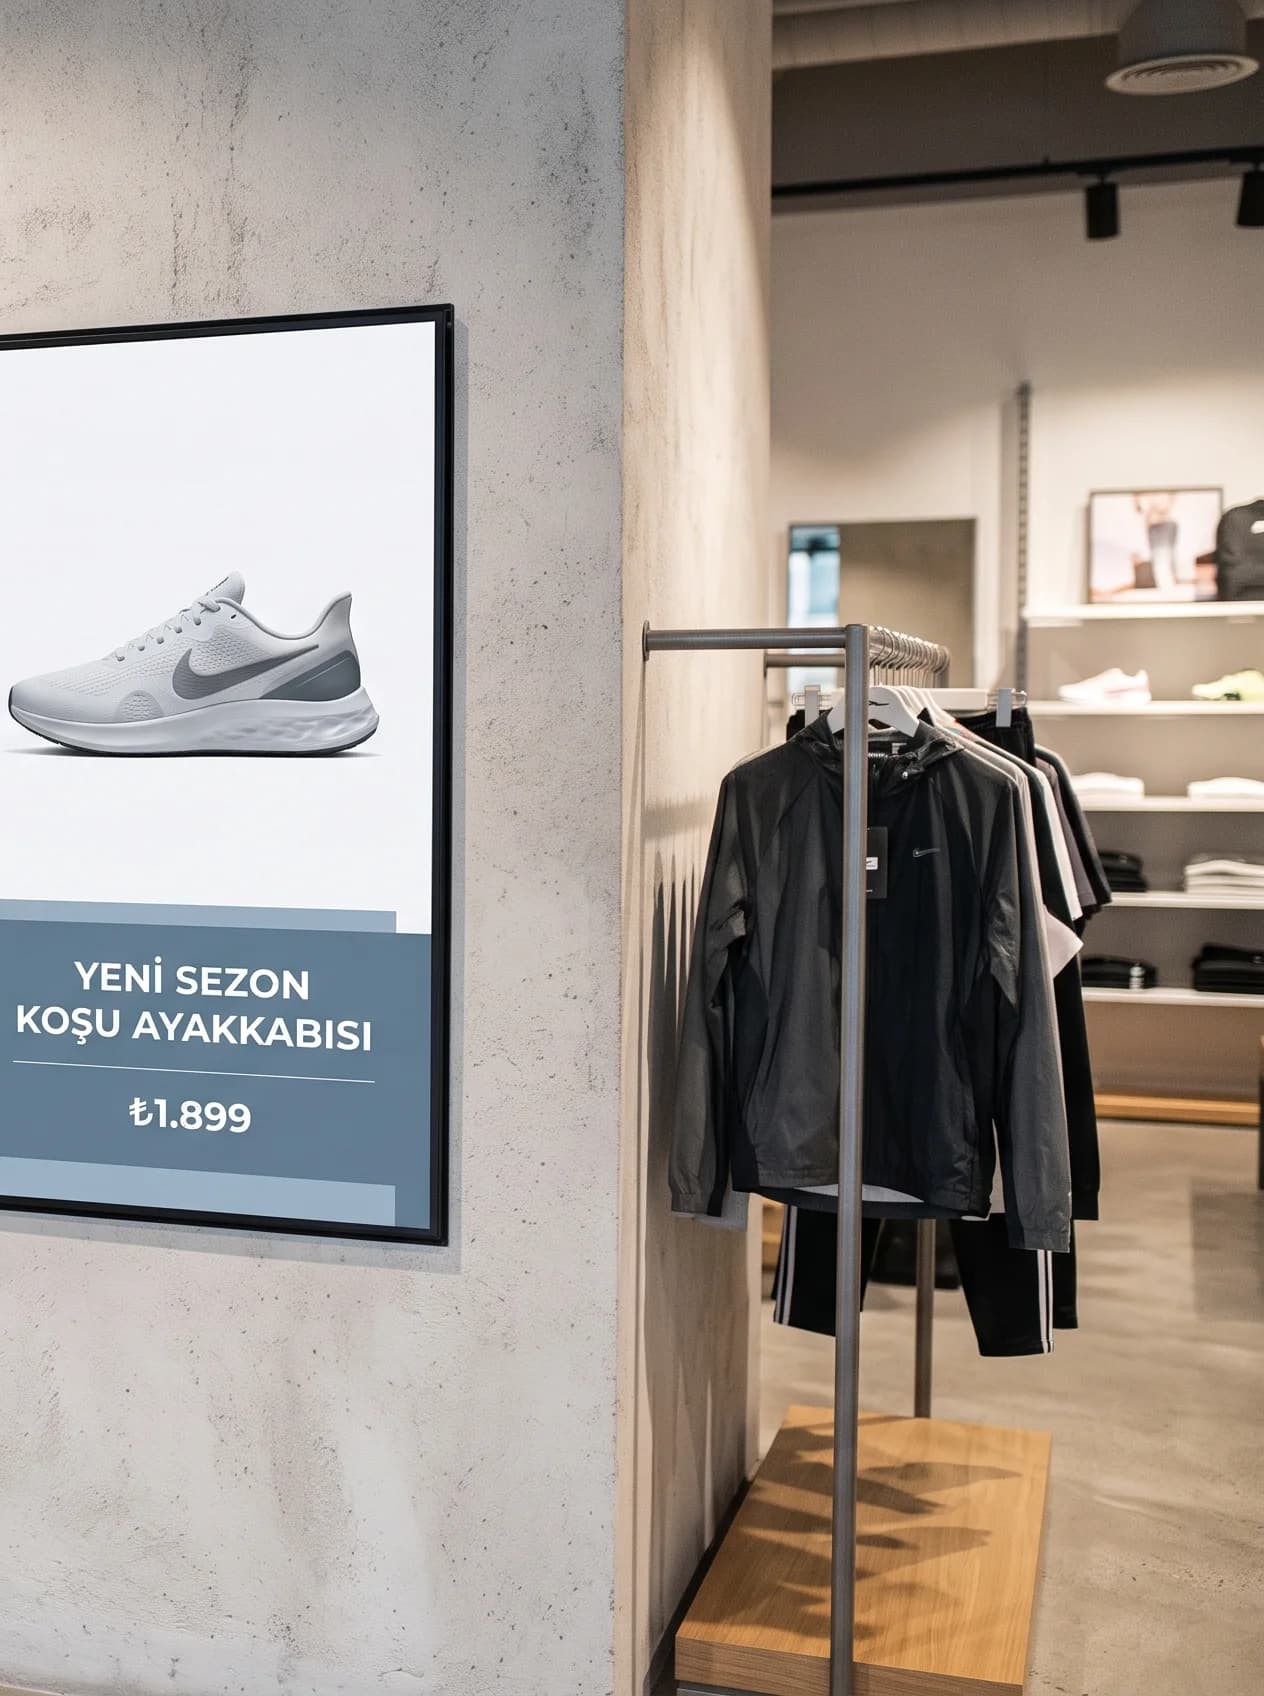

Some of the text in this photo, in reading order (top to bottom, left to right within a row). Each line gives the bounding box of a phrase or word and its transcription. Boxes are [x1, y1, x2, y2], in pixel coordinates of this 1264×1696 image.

[74, 956, 309, 1000] YENİ SEZON
[17, 1005, 371, 1051] KOŞU AYAKKABISI
[129, 1097, 252, 1133] ₺1.899
